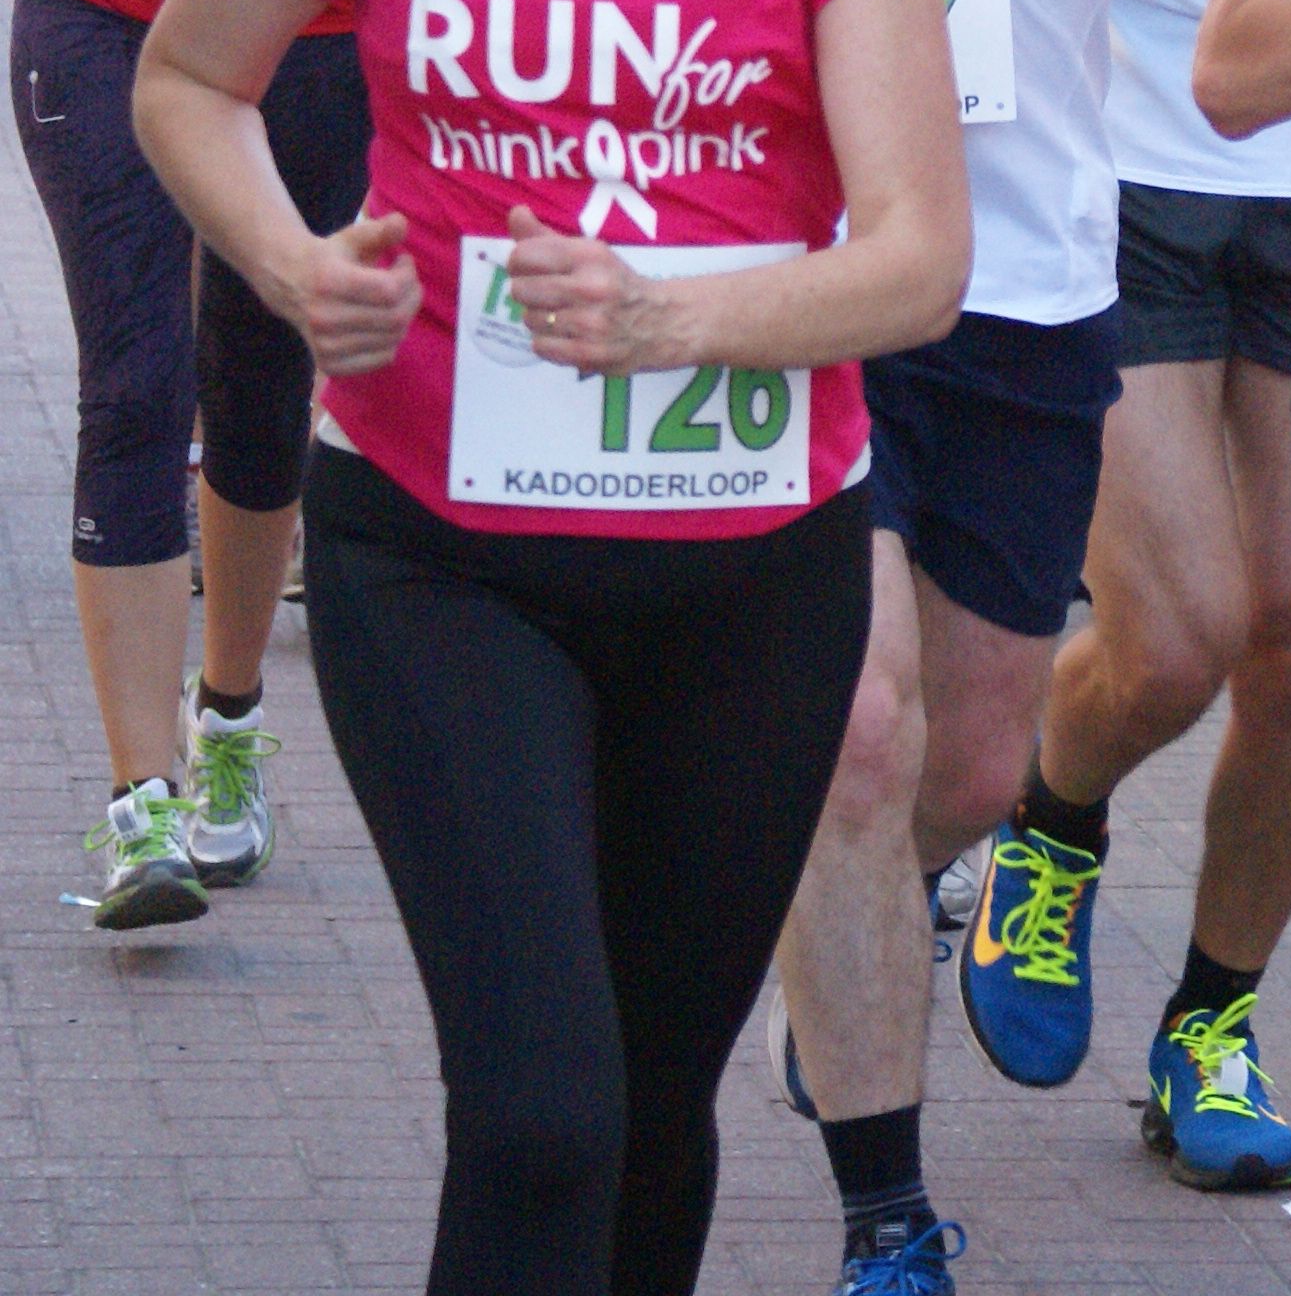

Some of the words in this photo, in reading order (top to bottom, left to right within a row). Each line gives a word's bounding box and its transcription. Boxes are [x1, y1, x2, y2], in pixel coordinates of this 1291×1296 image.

[653, 18, 773, 131] for
[419, 113, 585, 180] think
[628, 122, 770, 191] pink
[504, 469, 769, 499] KADODDERLOOP
